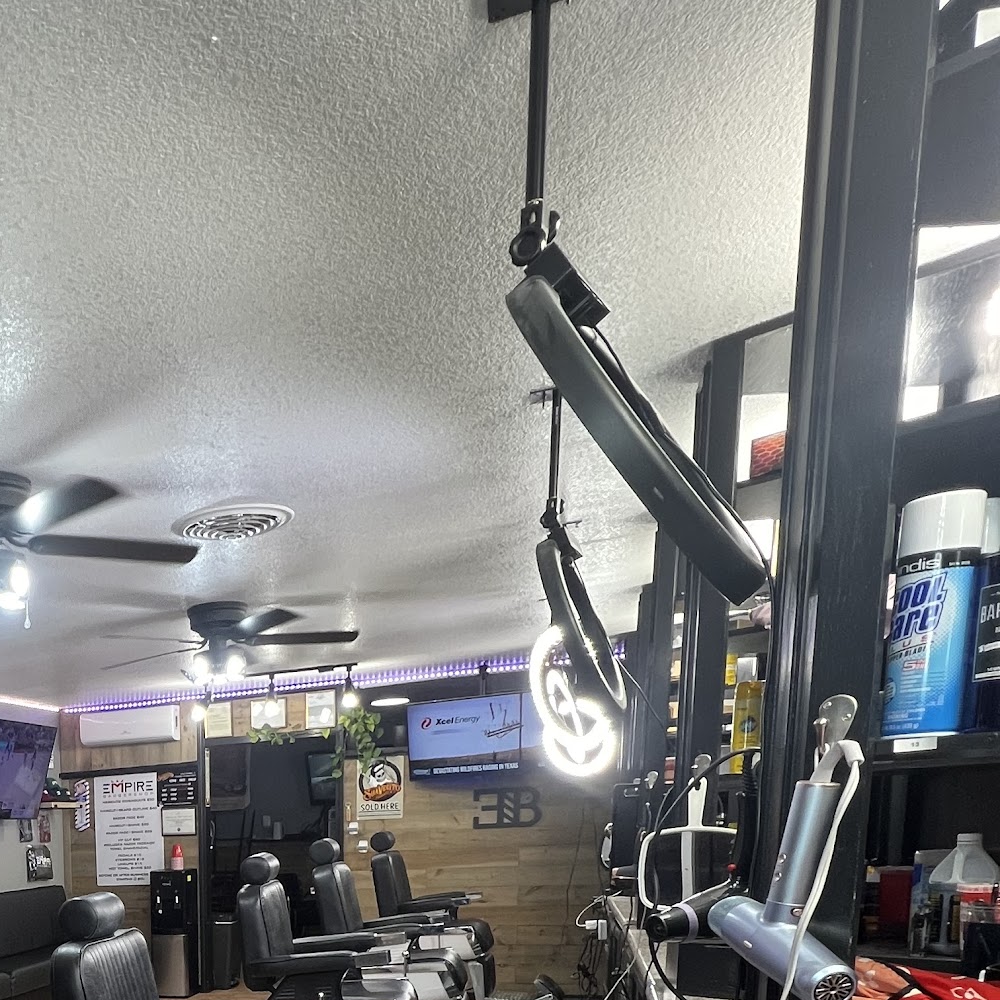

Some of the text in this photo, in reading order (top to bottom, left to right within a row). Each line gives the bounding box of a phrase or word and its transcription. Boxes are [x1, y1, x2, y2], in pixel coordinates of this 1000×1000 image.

[899, 558, 941, 573] ndis
[435, 715, 480, 725] Xcel Energy
[103, 780, 153, 793] EMPIRE
[361, 803, 379, 811] SOLD
